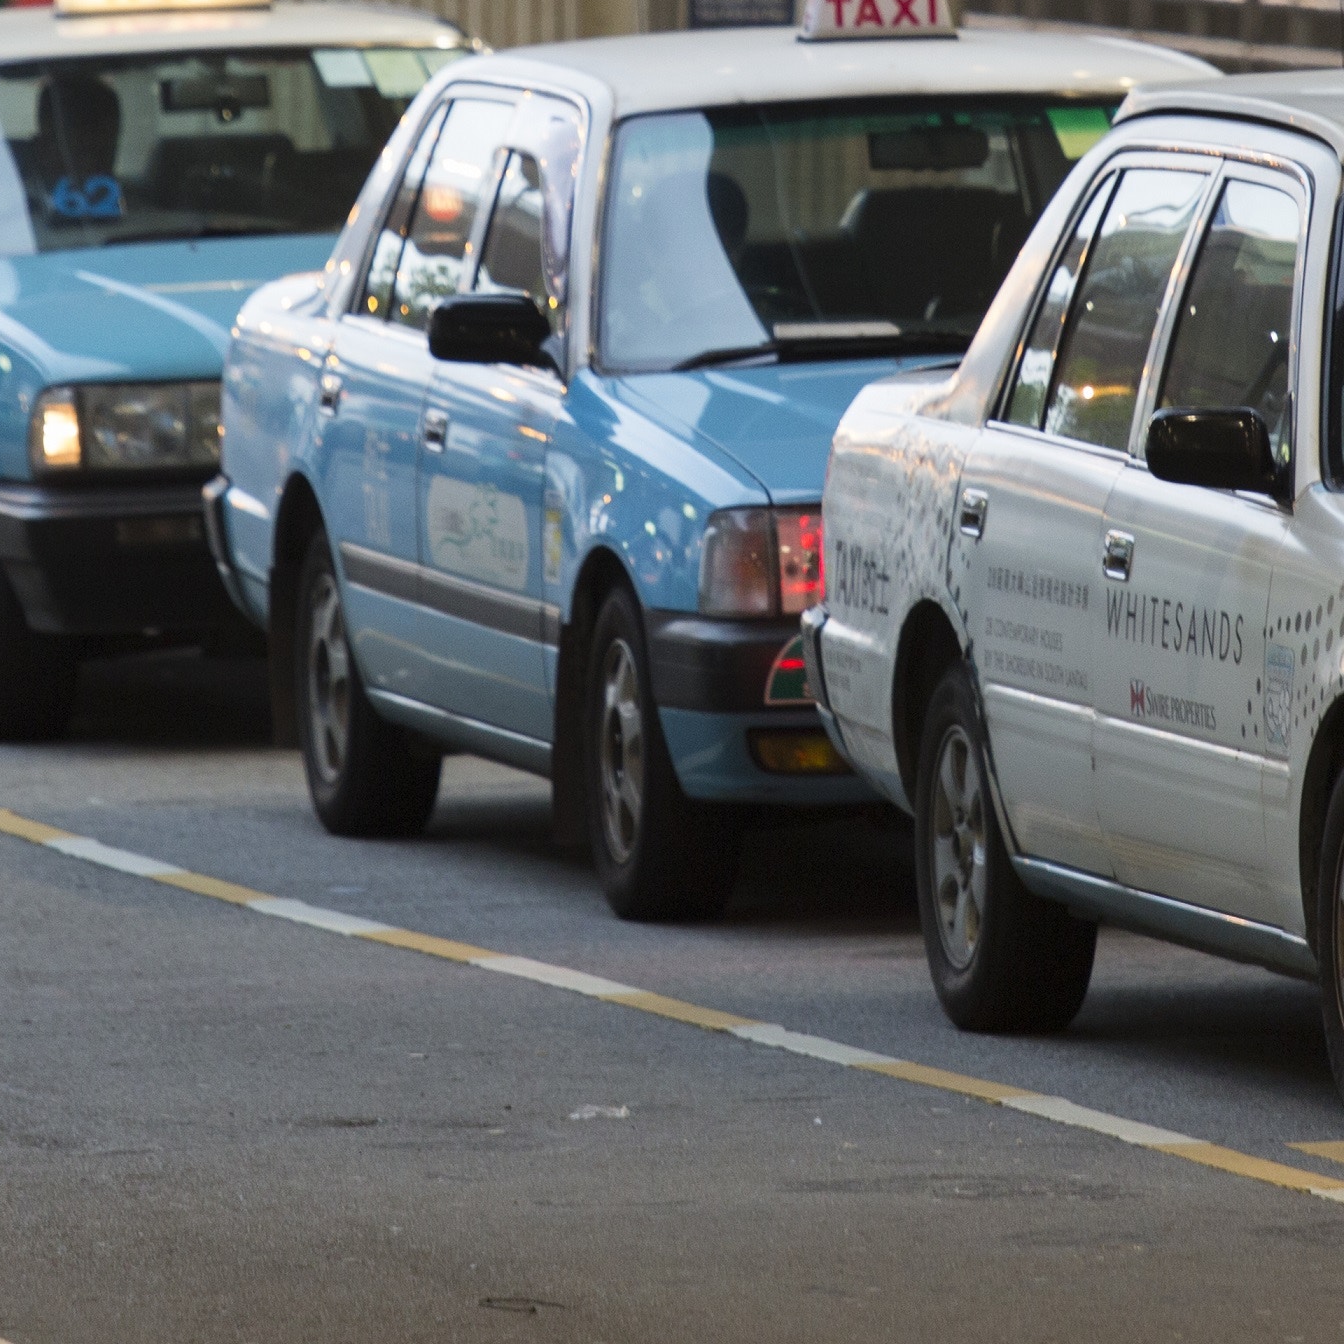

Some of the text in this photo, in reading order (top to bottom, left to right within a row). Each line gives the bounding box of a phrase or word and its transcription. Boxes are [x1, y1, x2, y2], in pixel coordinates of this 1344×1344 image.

[52, 174, 122, 218] 62
[1106, 587, 1244, 665] WHITESANDS
[1170, 696, 1217, 730] PROPERTIES
